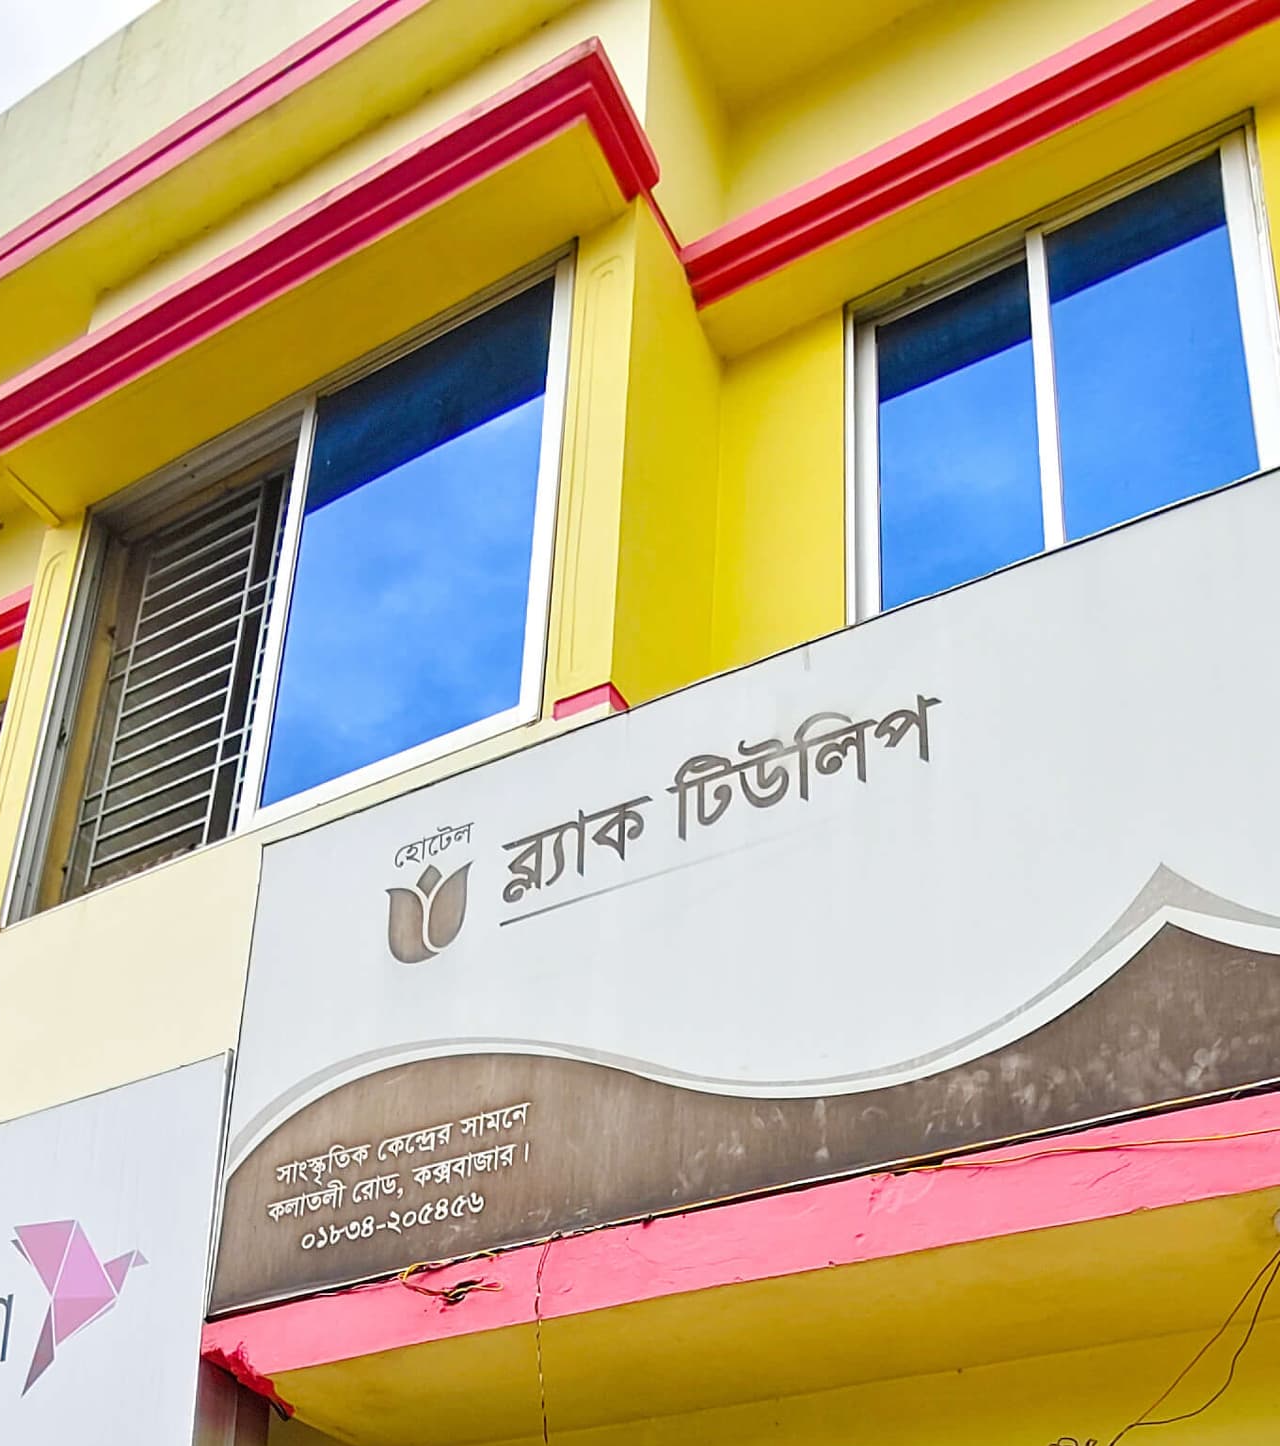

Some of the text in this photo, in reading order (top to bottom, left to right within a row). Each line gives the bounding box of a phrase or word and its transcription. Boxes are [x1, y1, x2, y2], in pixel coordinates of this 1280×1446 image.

[502, 694, 942, 903] ব্ল্যাক টিউলিপ
[393, 822, 474, 867] হোটেল
[276, 1102, 531, 1186] সাংস্কৃতিক কেন্দ্রের সামনে
[267, 1179, 347, 1222] কলাতলী
[352, 1173, 404, 1201] রোড,
[301, 1192, 484, 1249] ০১৮৩৪-২০৫৪৫৬
